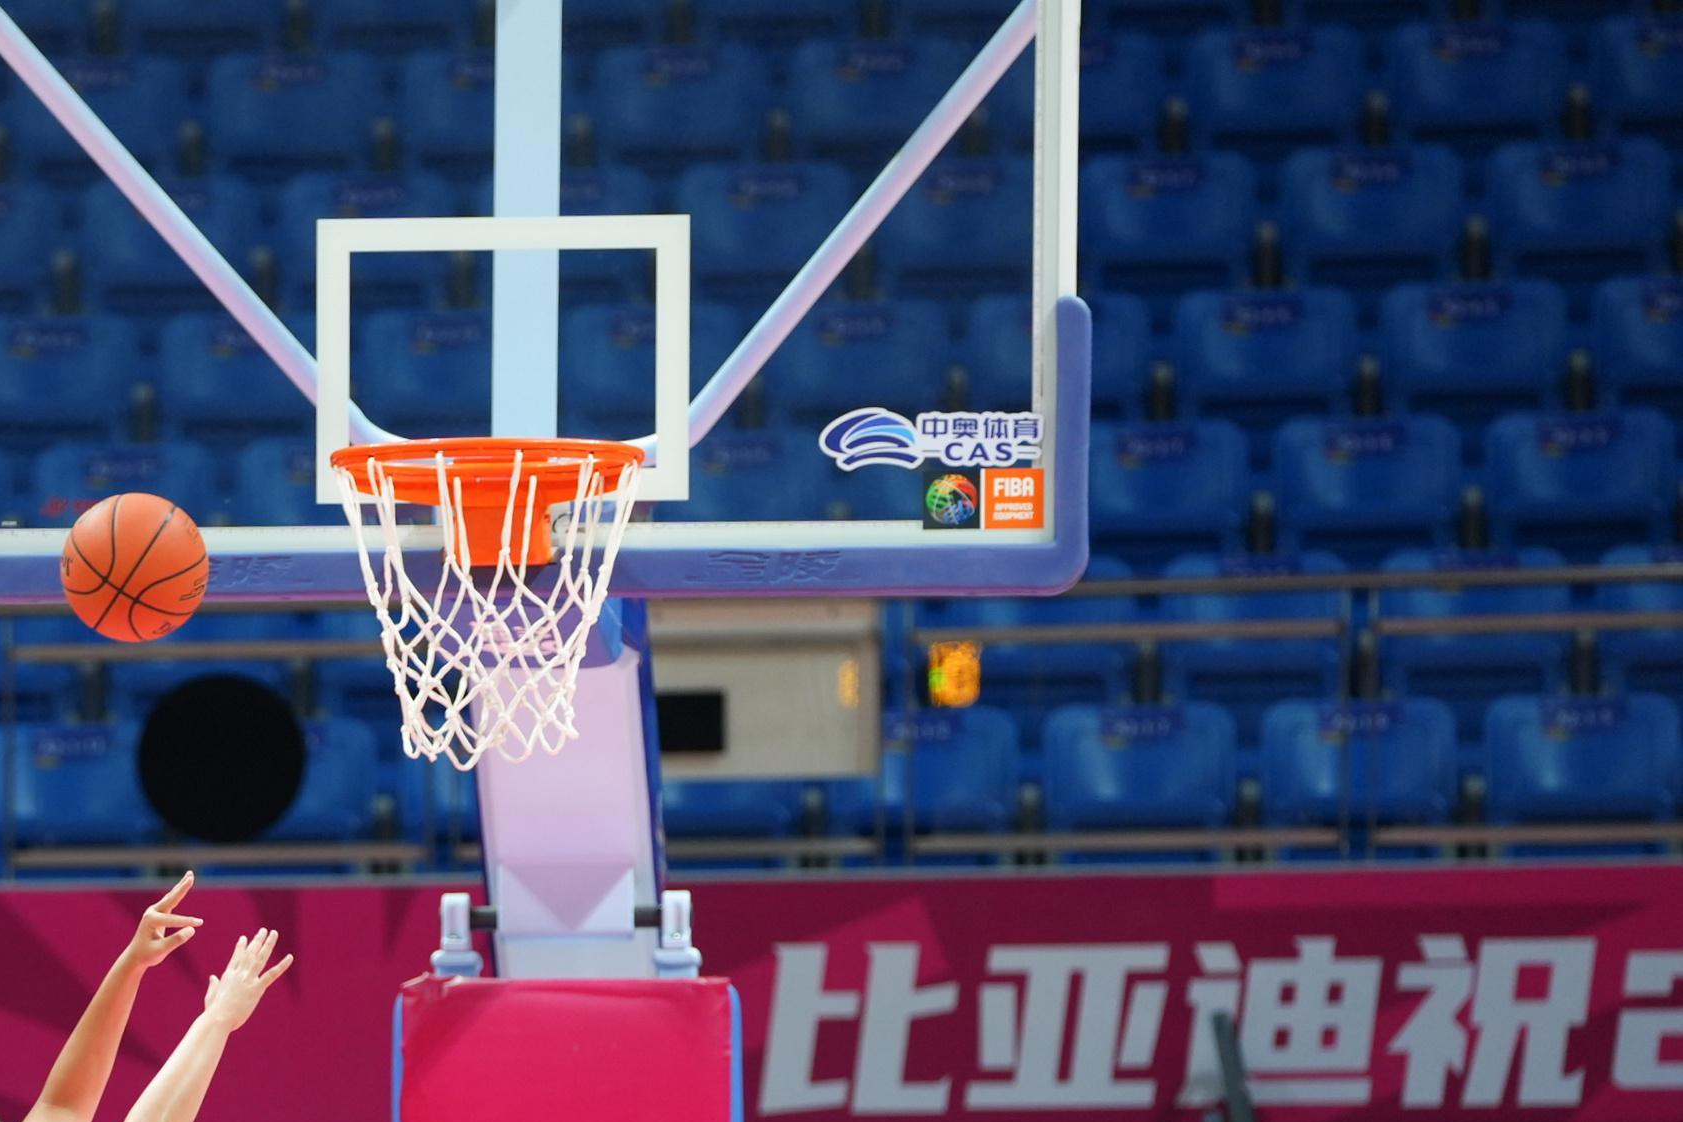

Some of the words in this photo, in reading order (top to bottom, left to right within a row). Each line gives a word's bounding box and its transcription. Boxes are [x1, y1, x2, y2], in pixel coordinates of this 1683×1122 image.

[921, 416, 1040, 440] 中奥体育
[944, 442, 1013, 462] CAS
[993, 476, 1035, 497] FIBA
